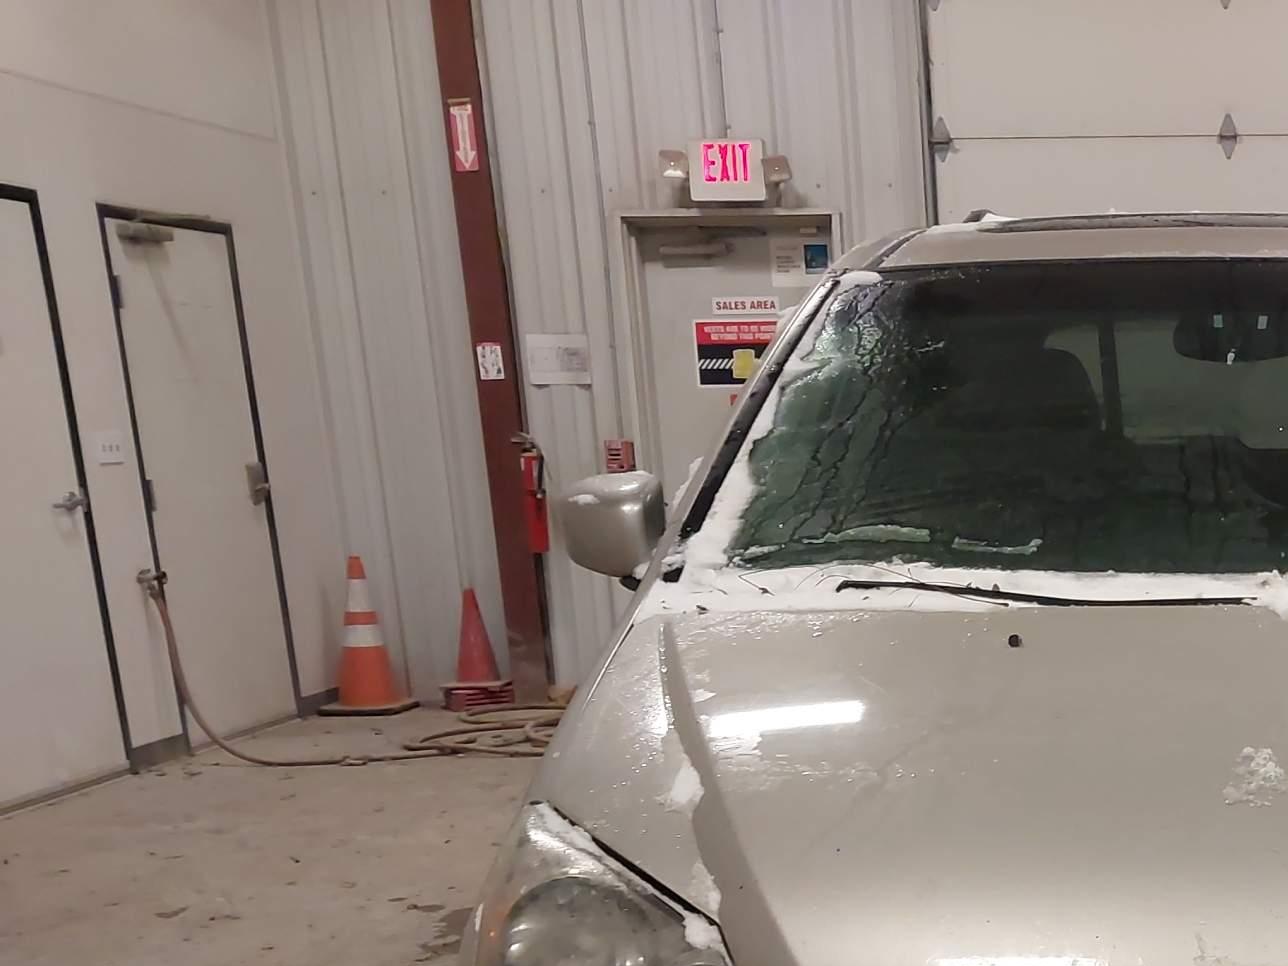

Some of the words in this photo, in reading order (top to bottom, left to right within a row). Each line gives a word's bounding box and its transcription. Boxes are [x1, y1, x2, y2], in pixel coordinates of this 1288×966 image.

[702, 143, 750, 182] EXIT
[716, 301, 746, 310] SALES
[749, 300, 776, 310] AREA
